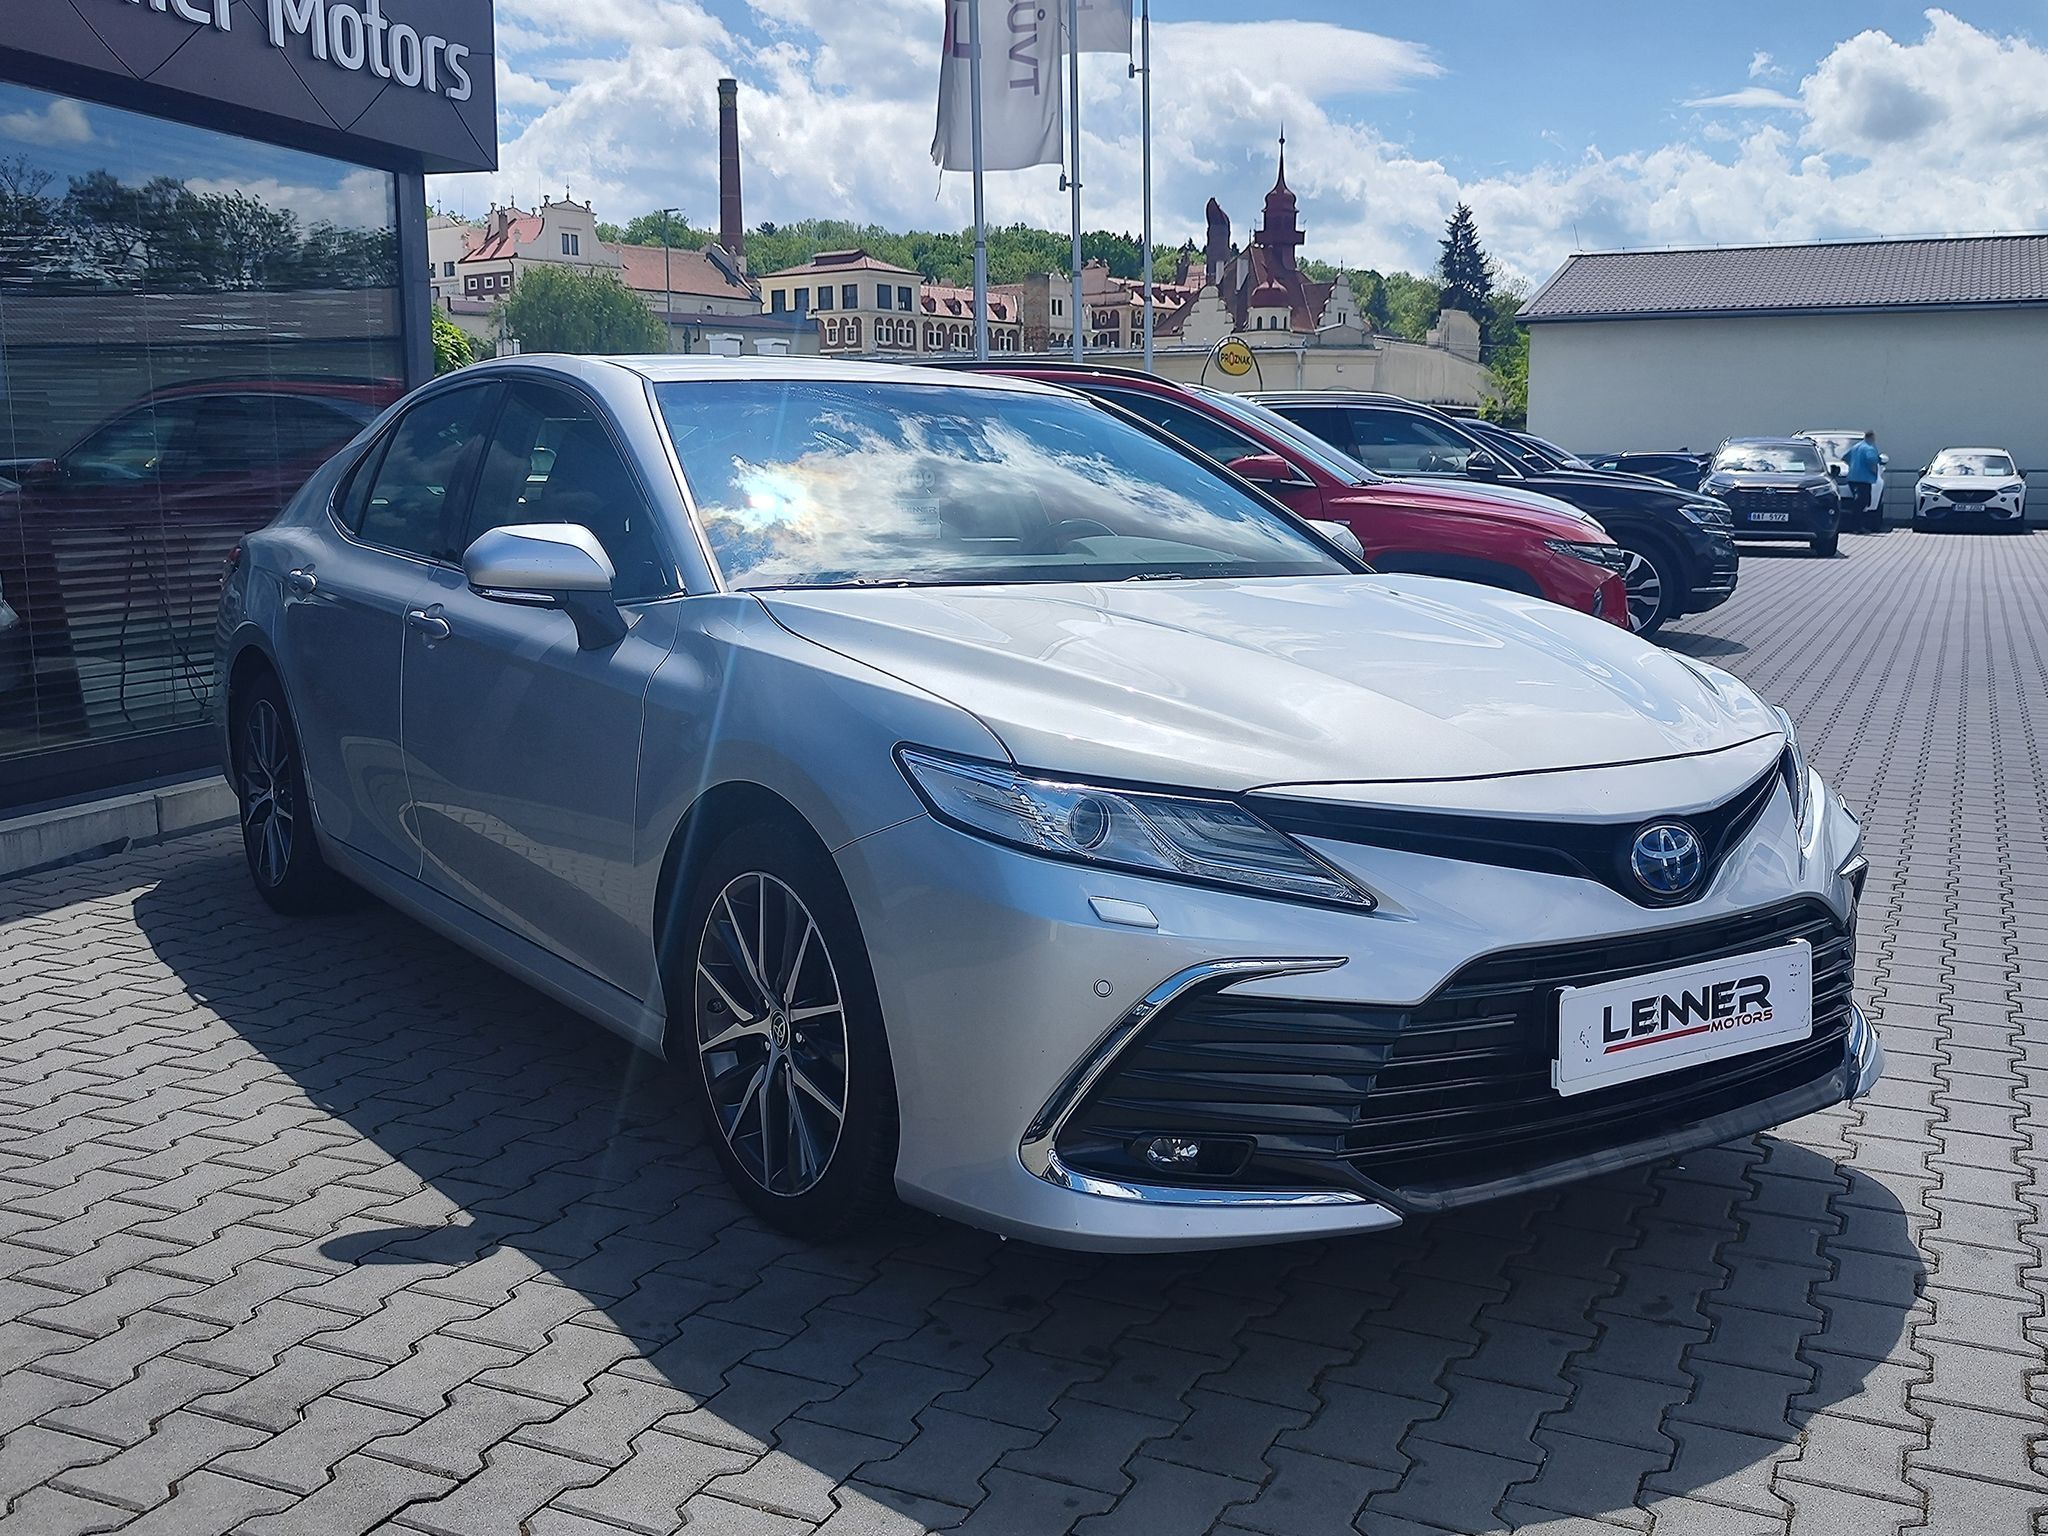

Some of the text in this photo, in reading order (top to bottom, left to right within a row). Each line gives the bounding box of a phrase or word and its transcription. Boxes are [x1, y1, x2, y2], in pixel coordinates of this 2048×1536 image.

[269, 0, 473, 101] Motors
[1603, 975, 1773, 1043] LENNER
[1710, 1010, 1773, 1033] MOTORS
